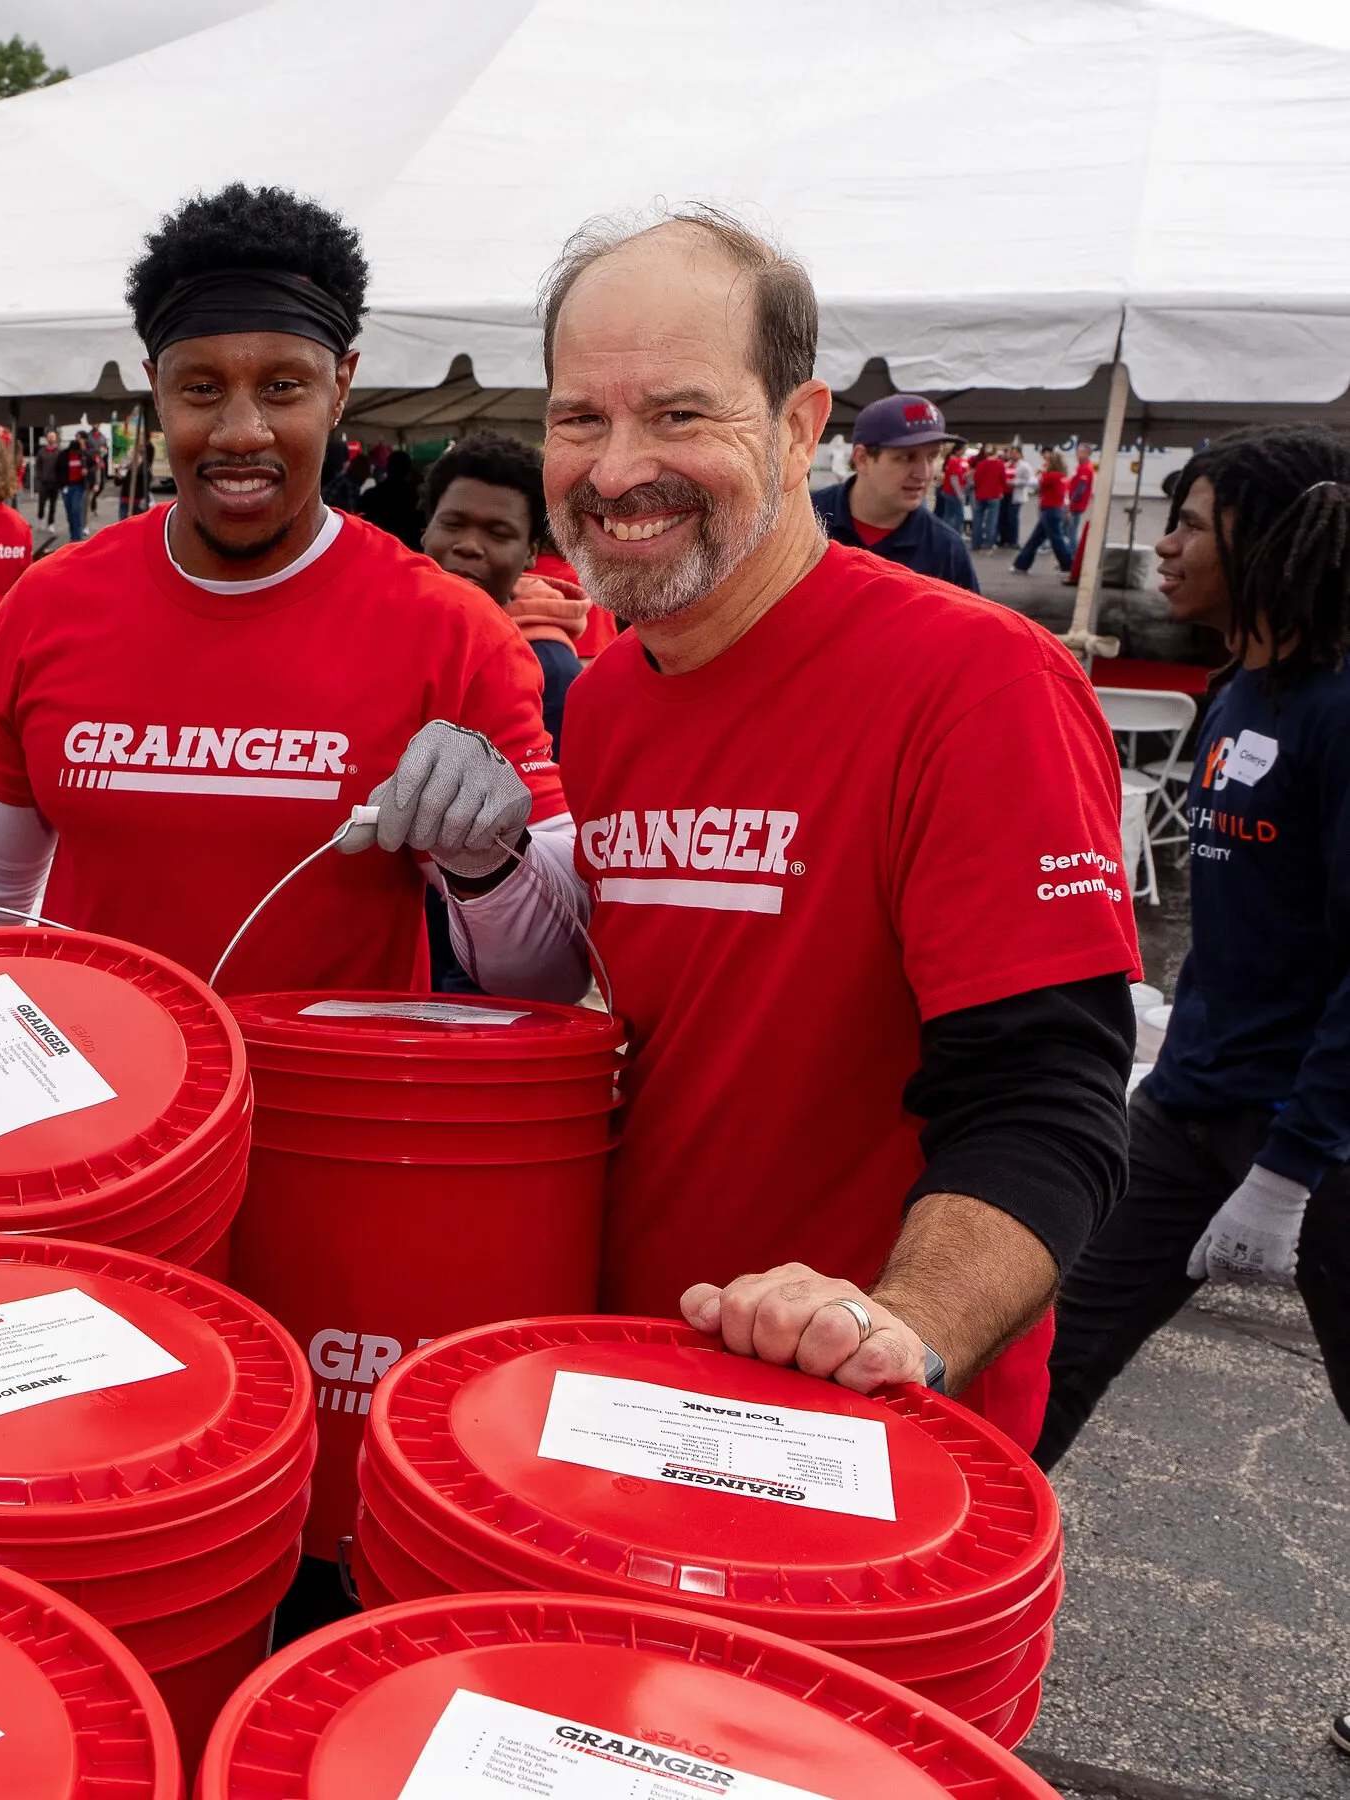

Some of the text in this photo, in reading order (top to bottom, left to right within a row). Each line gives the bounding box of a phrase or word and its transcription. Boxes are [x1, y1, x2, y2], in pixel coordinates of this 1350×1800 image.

[17, 1004, 70, 1055] GRAINGER
[746, 1413, 784, 1426] Tool
[662, 1468, 805, 1500] GRAINGER
[497, 1742, 521, 1754] Trash
[523, 1744, 558, 1758] Storage
[556, 1726, 733, 1785] GRAINGER
[640, 1727, 730, 1764] COVER
[485, 1762, 514, 1777] Safety
[489, 1756, 545, 1778] Scrub Brush
[492, 1749, 558, 1774] Scouring Pads
